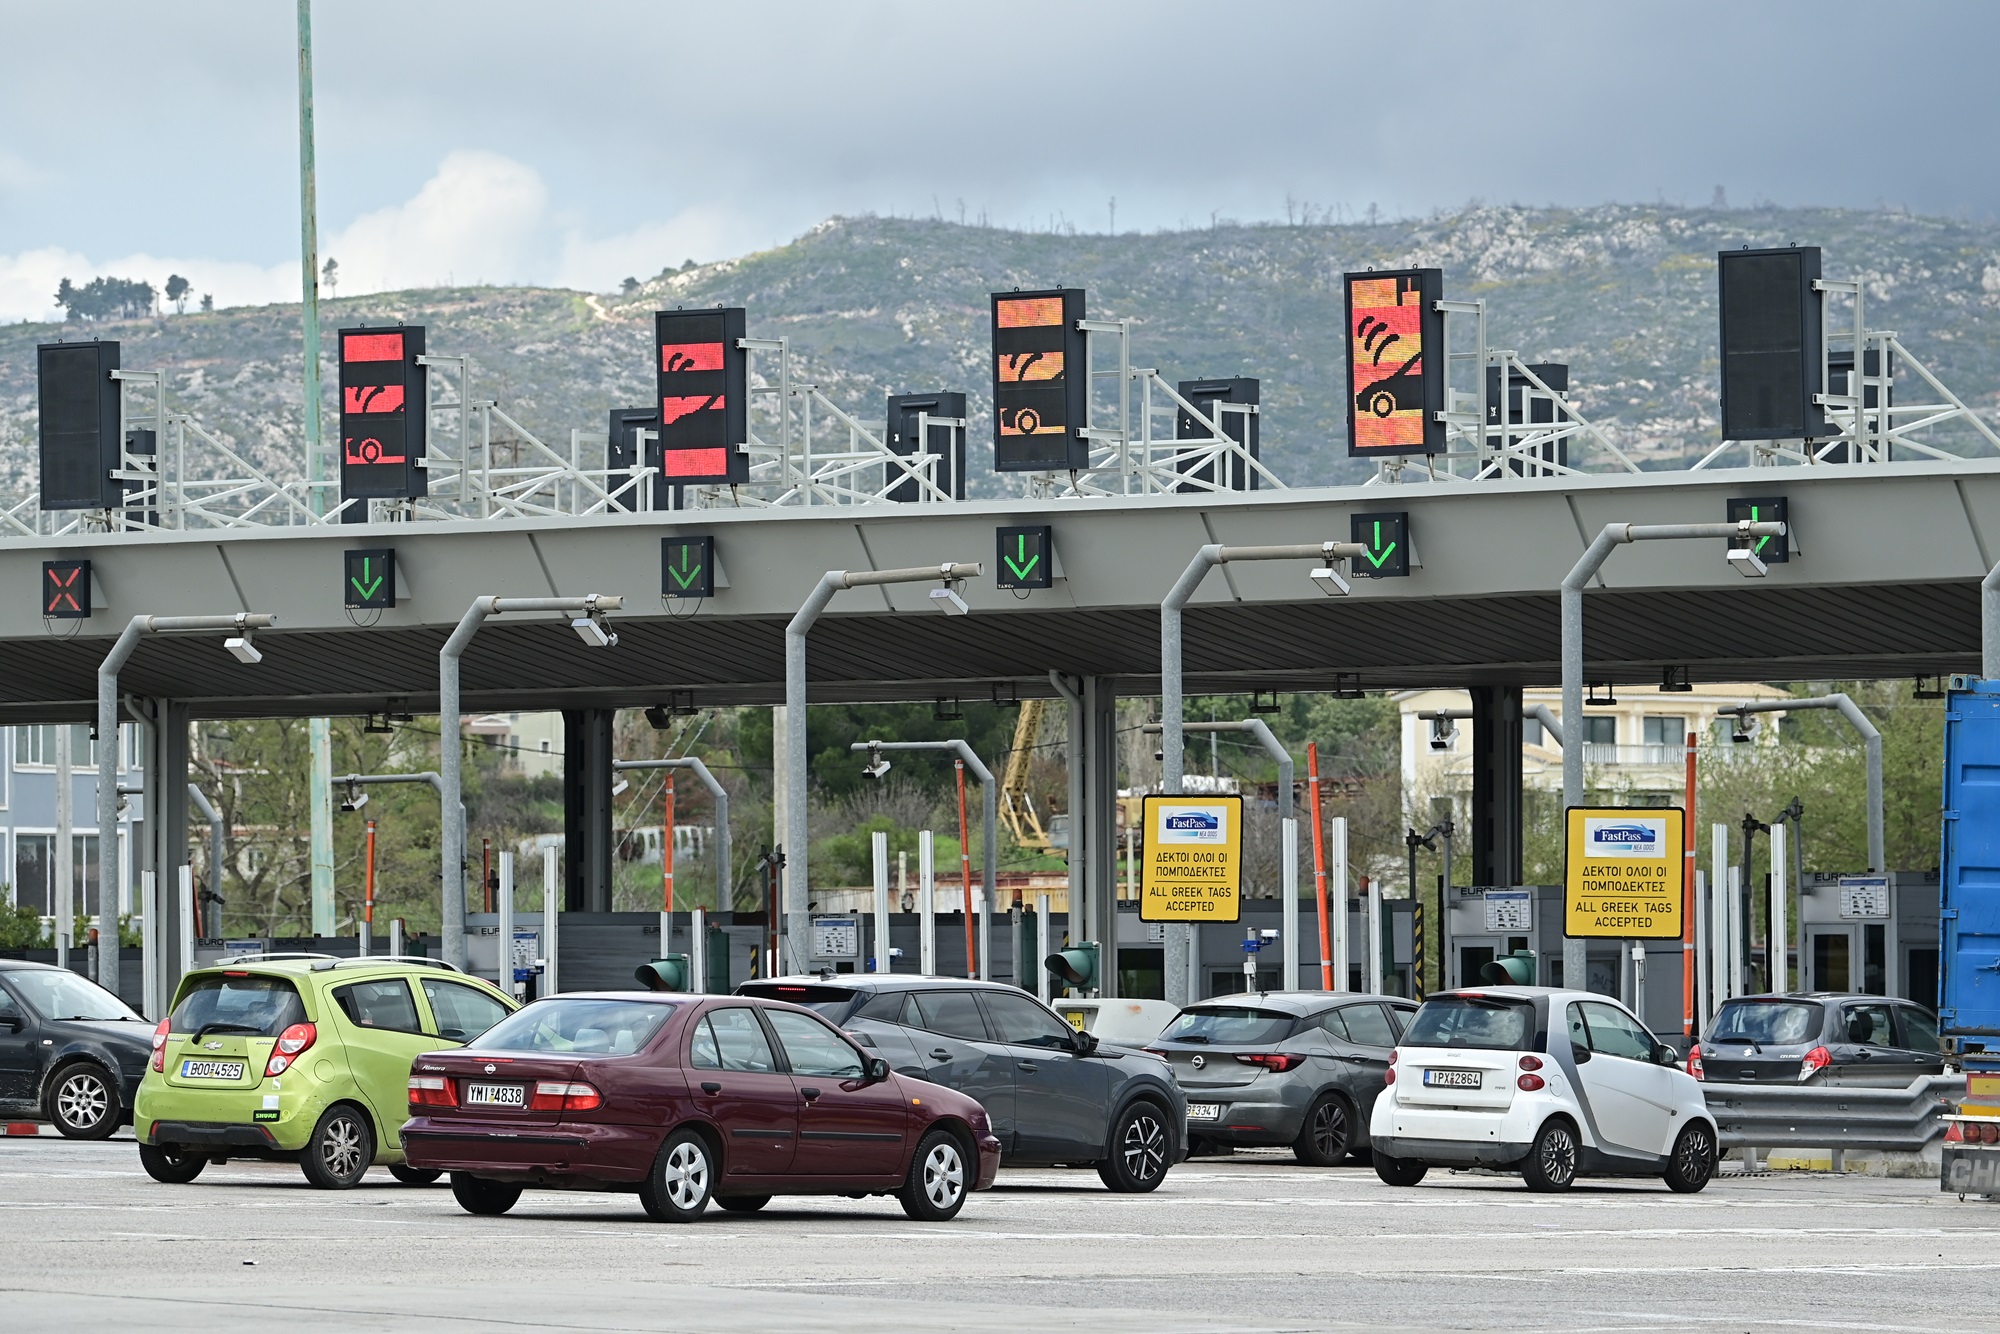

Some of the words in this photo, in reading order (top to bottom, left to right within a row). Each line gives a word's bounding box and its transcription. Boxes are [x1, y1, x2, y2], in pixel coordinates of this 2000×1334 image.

[1172, 818, 1207, 828] FastPass
[1601, 831, 1641, 841] FastPass
[1156, 852, 1189, 862] ΔΕΚΤΟΙ
[1193, 852, 1214, 863] ΟΛΟΙ
[1218, 853, 1227, 863] ΟΙ
[1156, 866, 1226, 877] ΠΟΜΠΟΔΕΚΤΕΣ
[1582, 866, 1621, 877] ΔΕΚΤΟΙ
[1626, 866, 1651, 877] ΟΛΟΙ
[1656, 866, 1666, 877] ΟΙ
[1582, 881, 1665, 892] ΠΟΜΠΟΔΕΚΤΕΣ
[1149, 887, 1167, 897] ALL
[1171, 887, 1203, 897] GREEK
[1208, 887, 1231, 898] TAGS
[1165, 901, 1214, 912] ACCEPTED
[1575, 902, 1596, 912] ALL
[1601, 902, 1638, 913] GREEK
[1645, 902, 1672, 913] TAGS
[1595, 917, 1652, 928] ACCEPTED
[1949, 1158, 2000, 1188] CH
